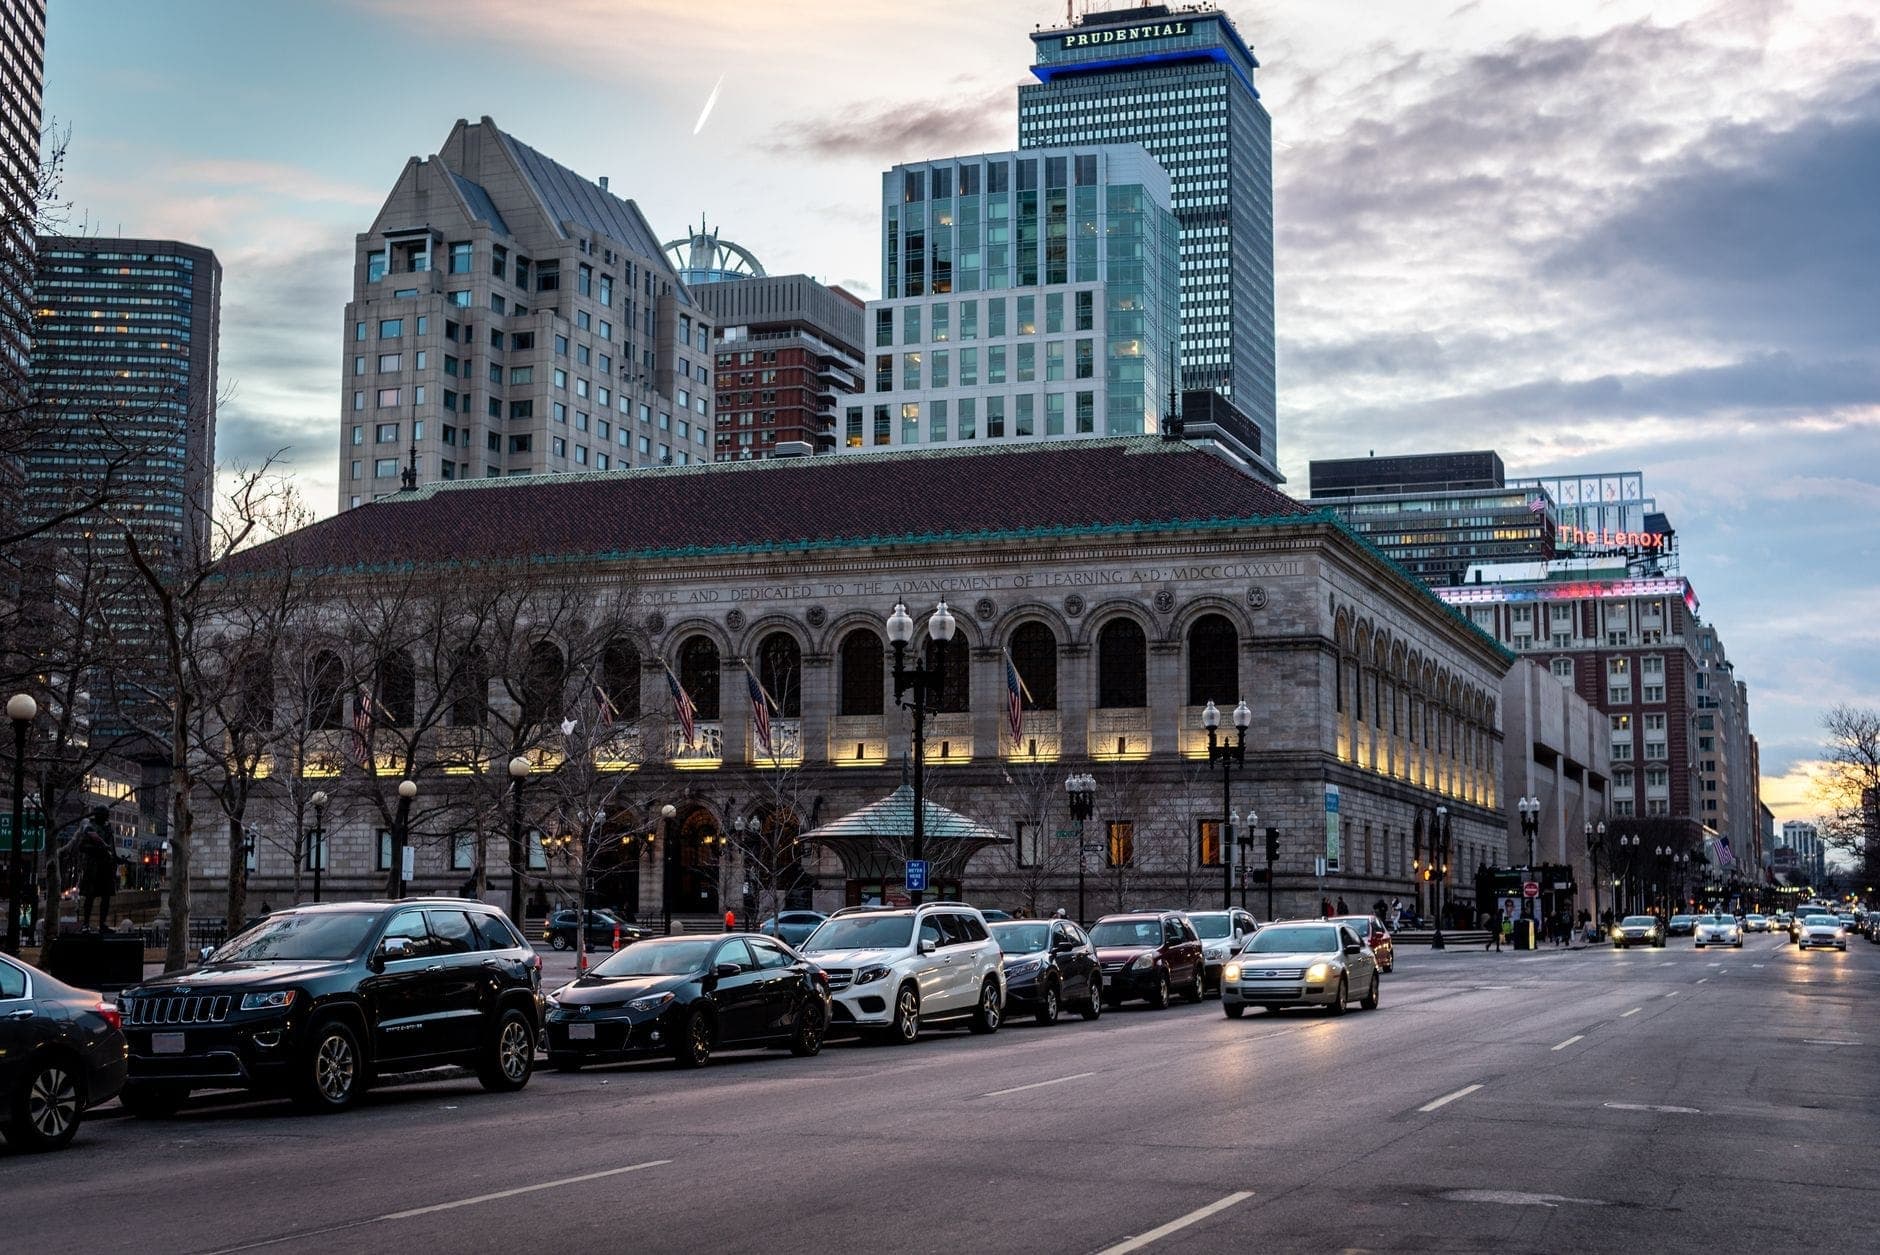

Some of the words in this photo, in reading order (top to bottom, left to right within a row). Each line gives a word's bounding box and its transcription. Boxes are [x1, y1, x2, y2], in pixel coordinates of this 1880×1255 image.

[1066, 22, 1187, 47] PRUDENTIAL
[1558, 525, 1597, 545] The
[1602, 527, 1664, 547] Lenox
[688, 590, 719, 602] AND
[730, 586, 812, 601] DEDICATED
[823, 584, 844, 596] TO
[853, 582, 883, 595] THE
[892, 576, 1002, 592] ADVANCEMENT
[1013, 575, 1034, 589] OF
[1045, 571, 1122, 586] LEARNING
